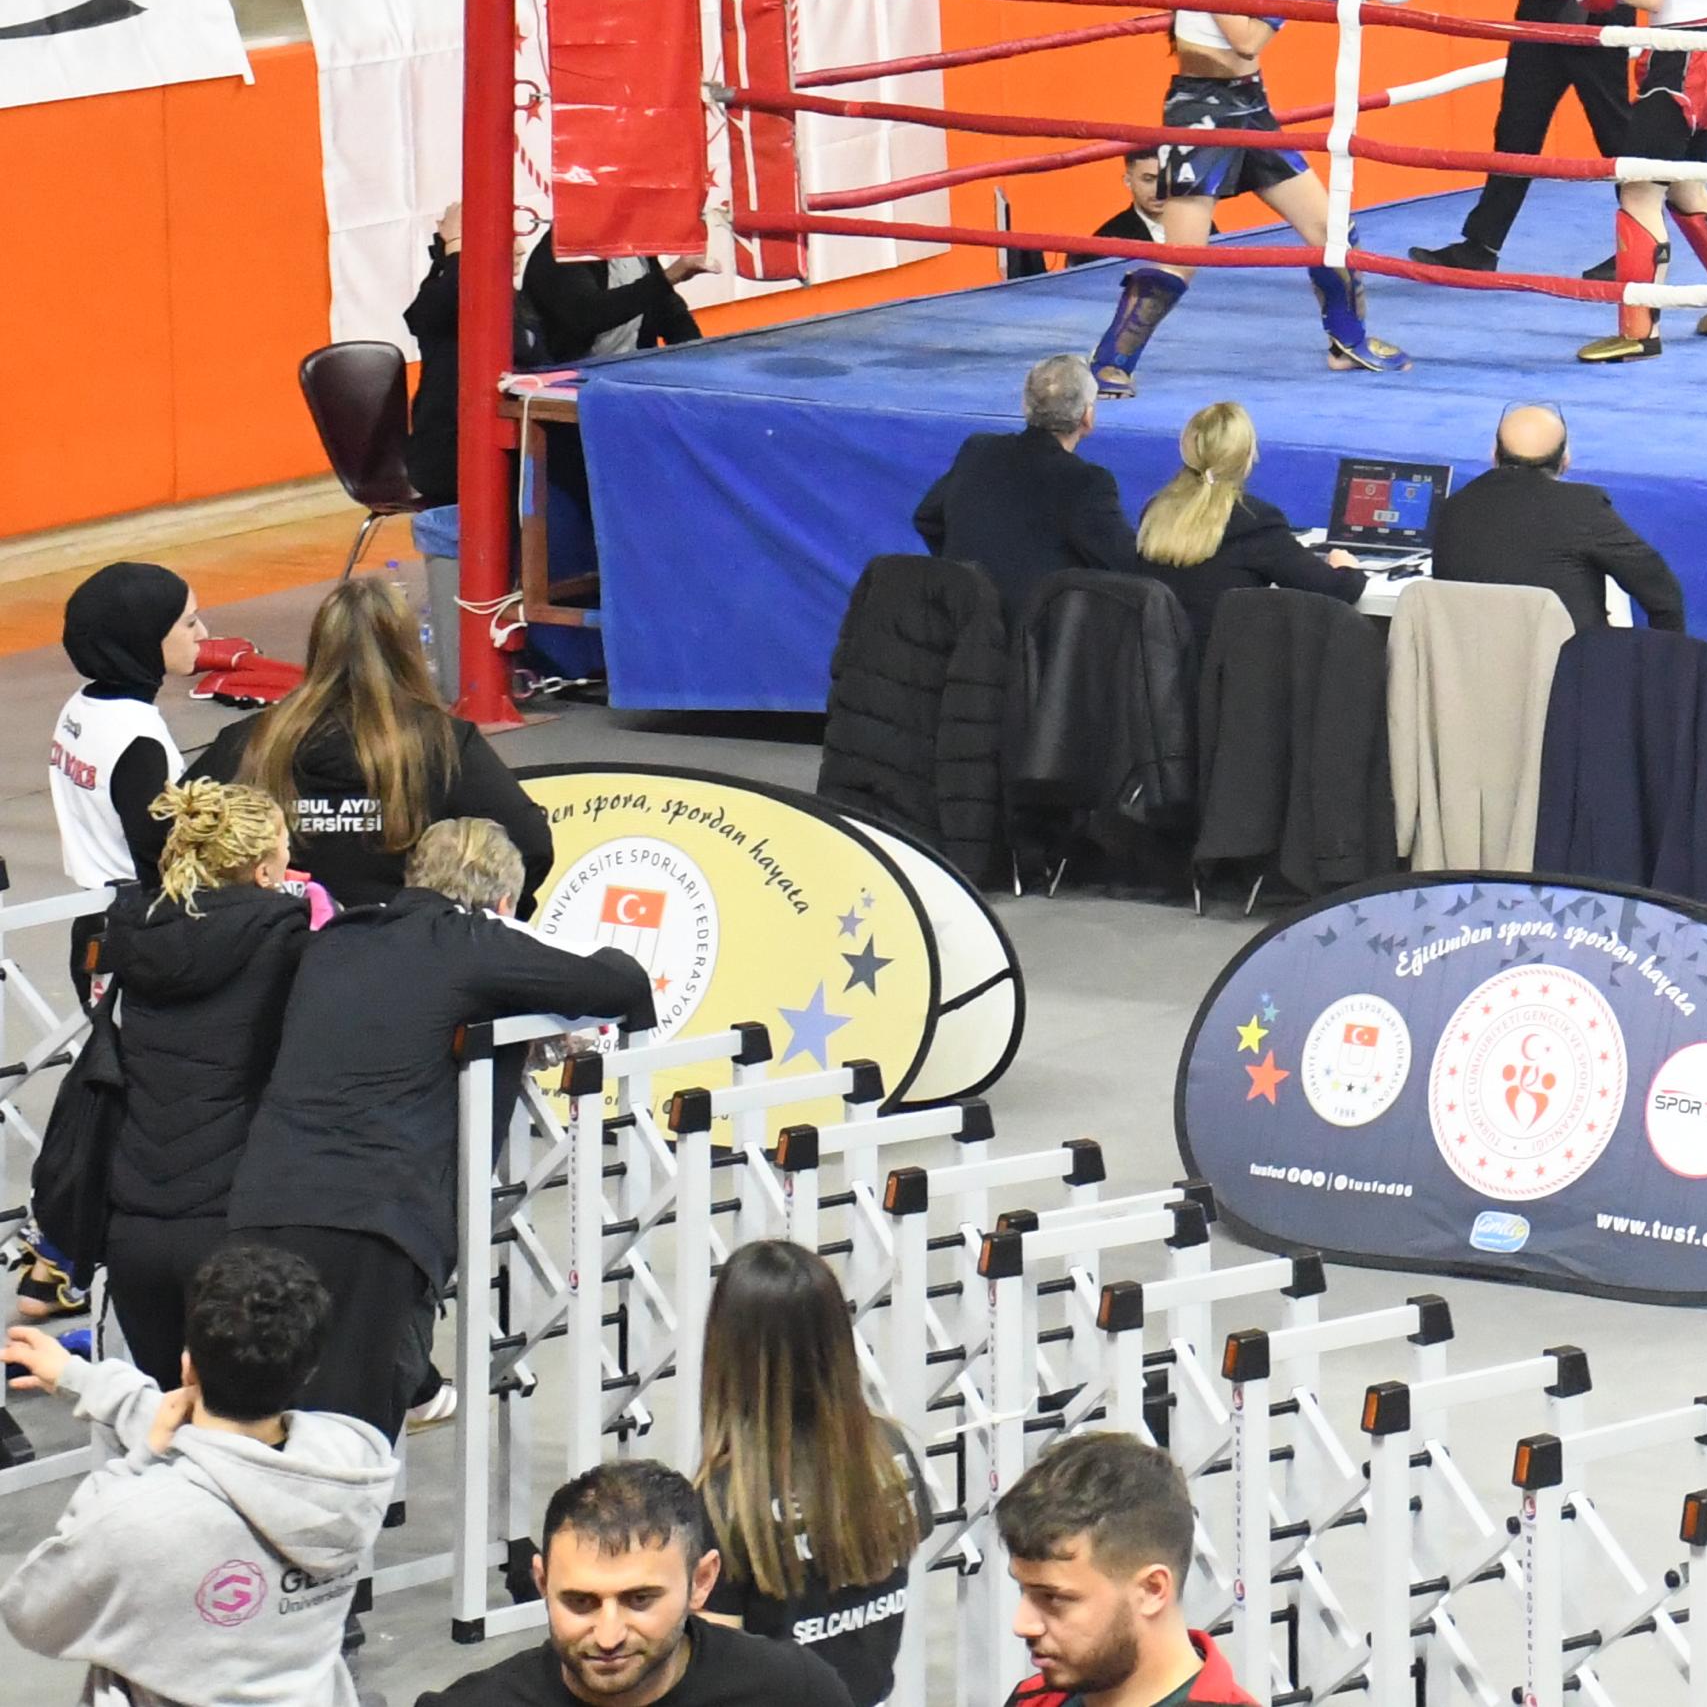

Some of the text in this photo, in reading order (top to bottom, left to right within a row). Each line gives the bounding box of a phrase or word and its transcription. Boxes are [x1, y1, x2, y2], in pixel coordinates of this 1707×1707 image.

[583, 792, 810, 916] spora, spordan hayata
[629, 848, 700, 902] SPORLARI
[1496, 920, 1558, 946] spora,
[1563, 923, 1639, 966] spordan
[1638, 953, 1697, 1016] hayata
